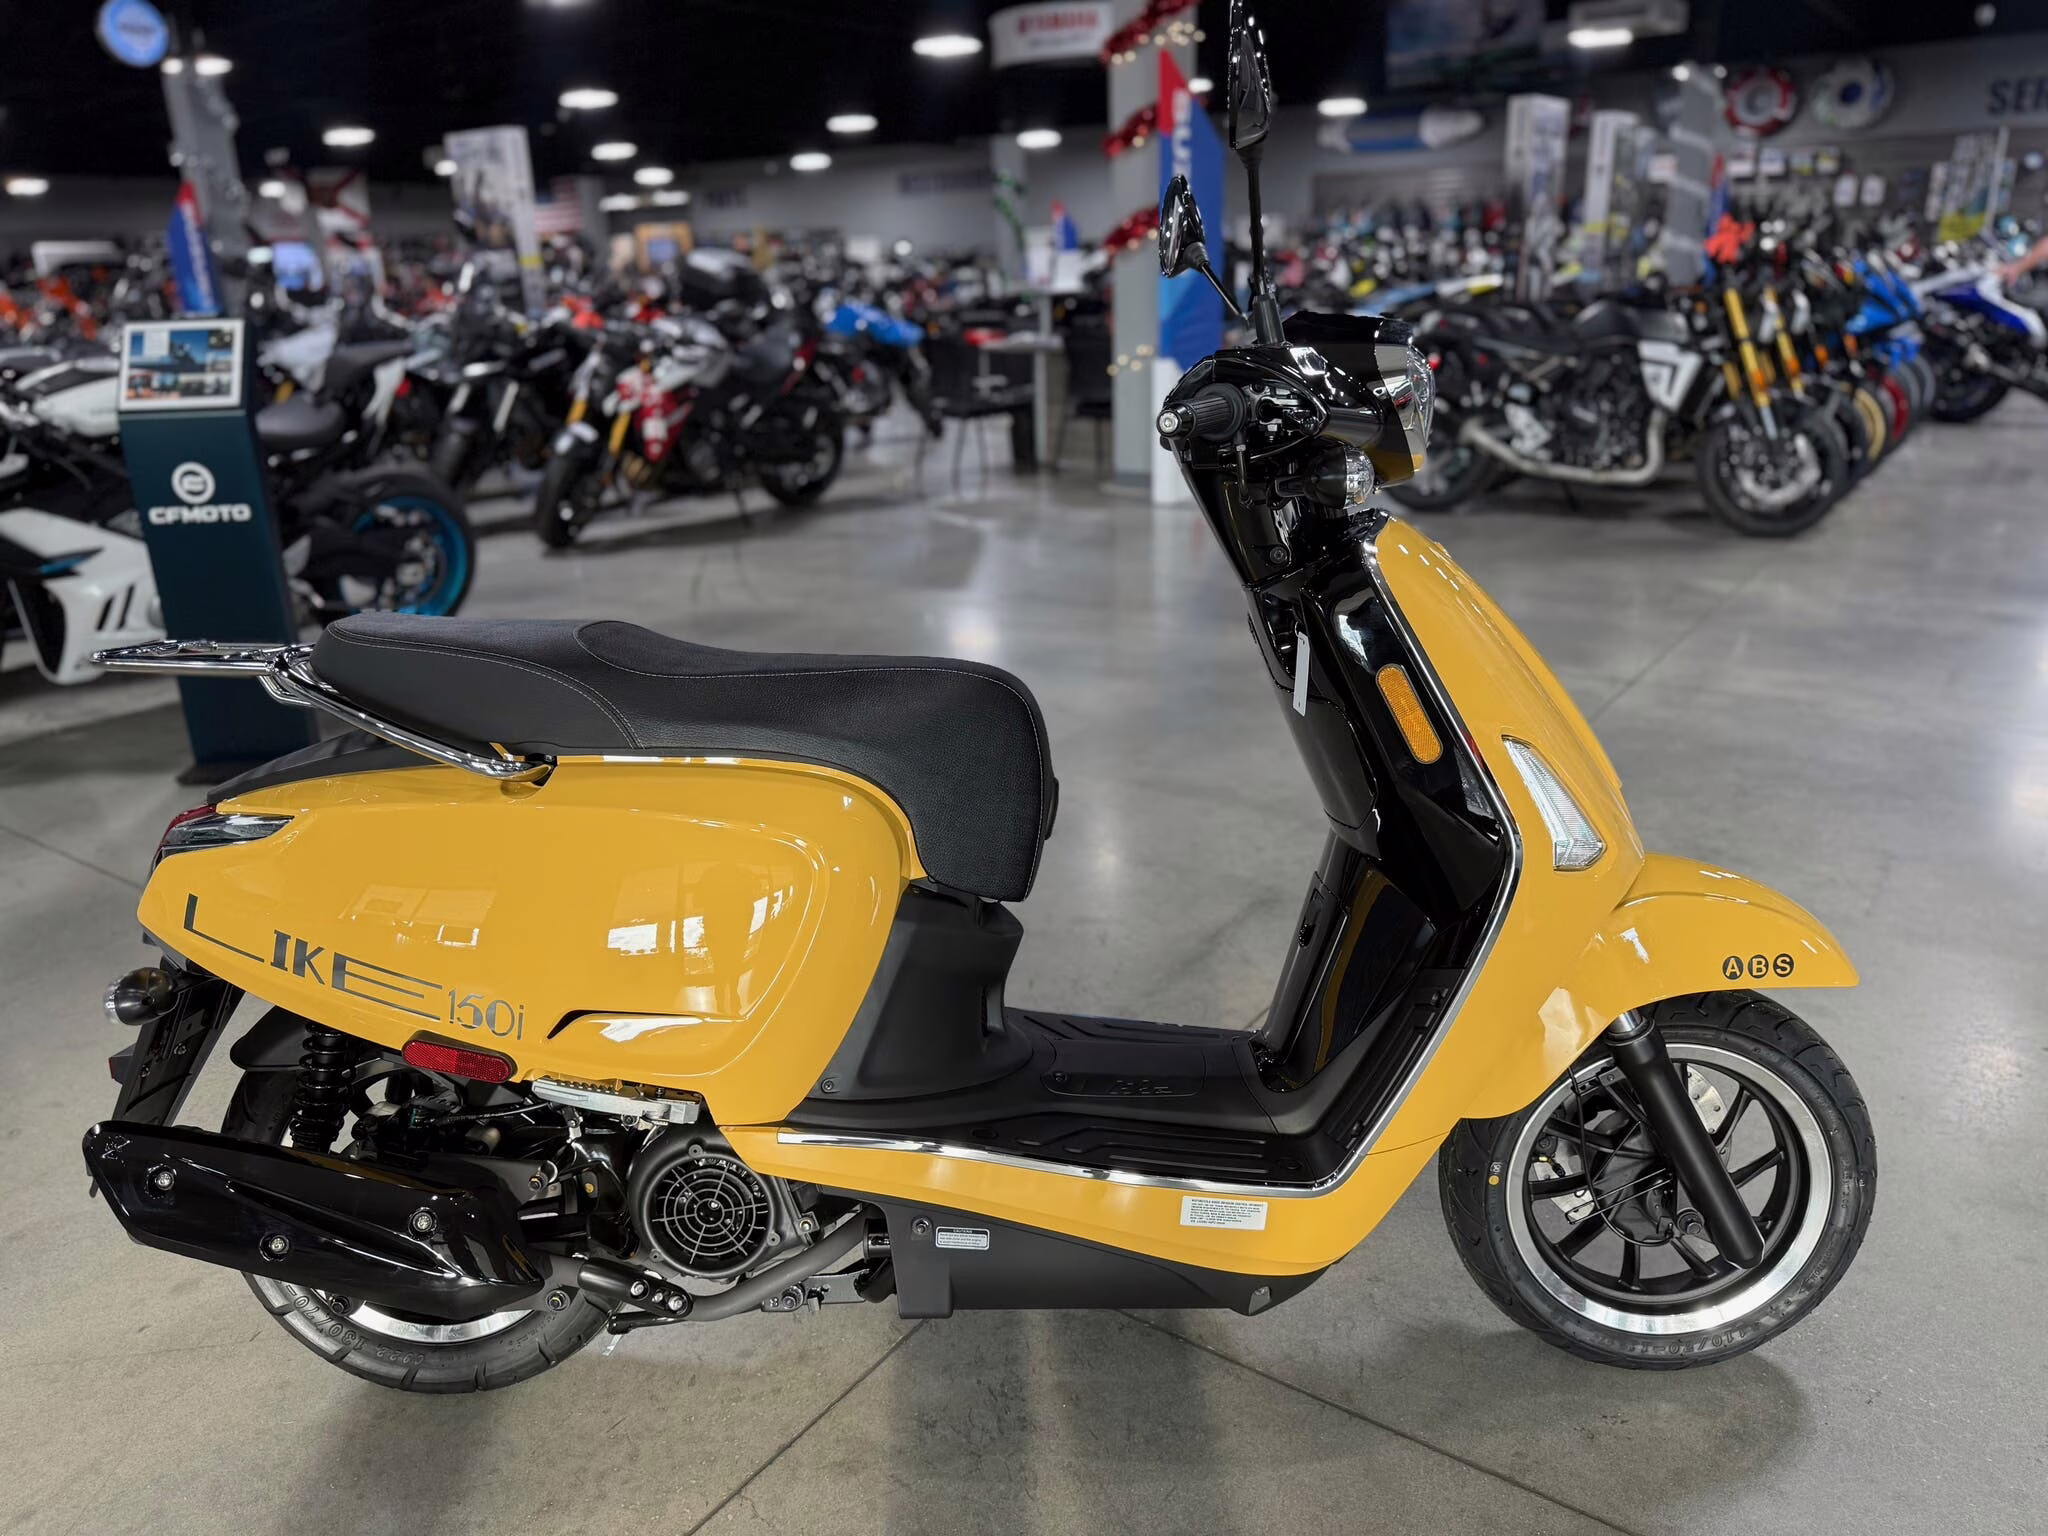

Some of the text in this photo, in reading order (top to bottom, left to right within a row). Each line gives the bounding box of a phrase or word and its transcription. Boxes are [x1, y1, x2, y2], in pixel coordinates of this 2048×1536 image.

[148, 503, 252, 525] CFMOTO
[184, 893, 525, 1041] LIKE 150i
[1724, 955, 1793, 979] ABS
